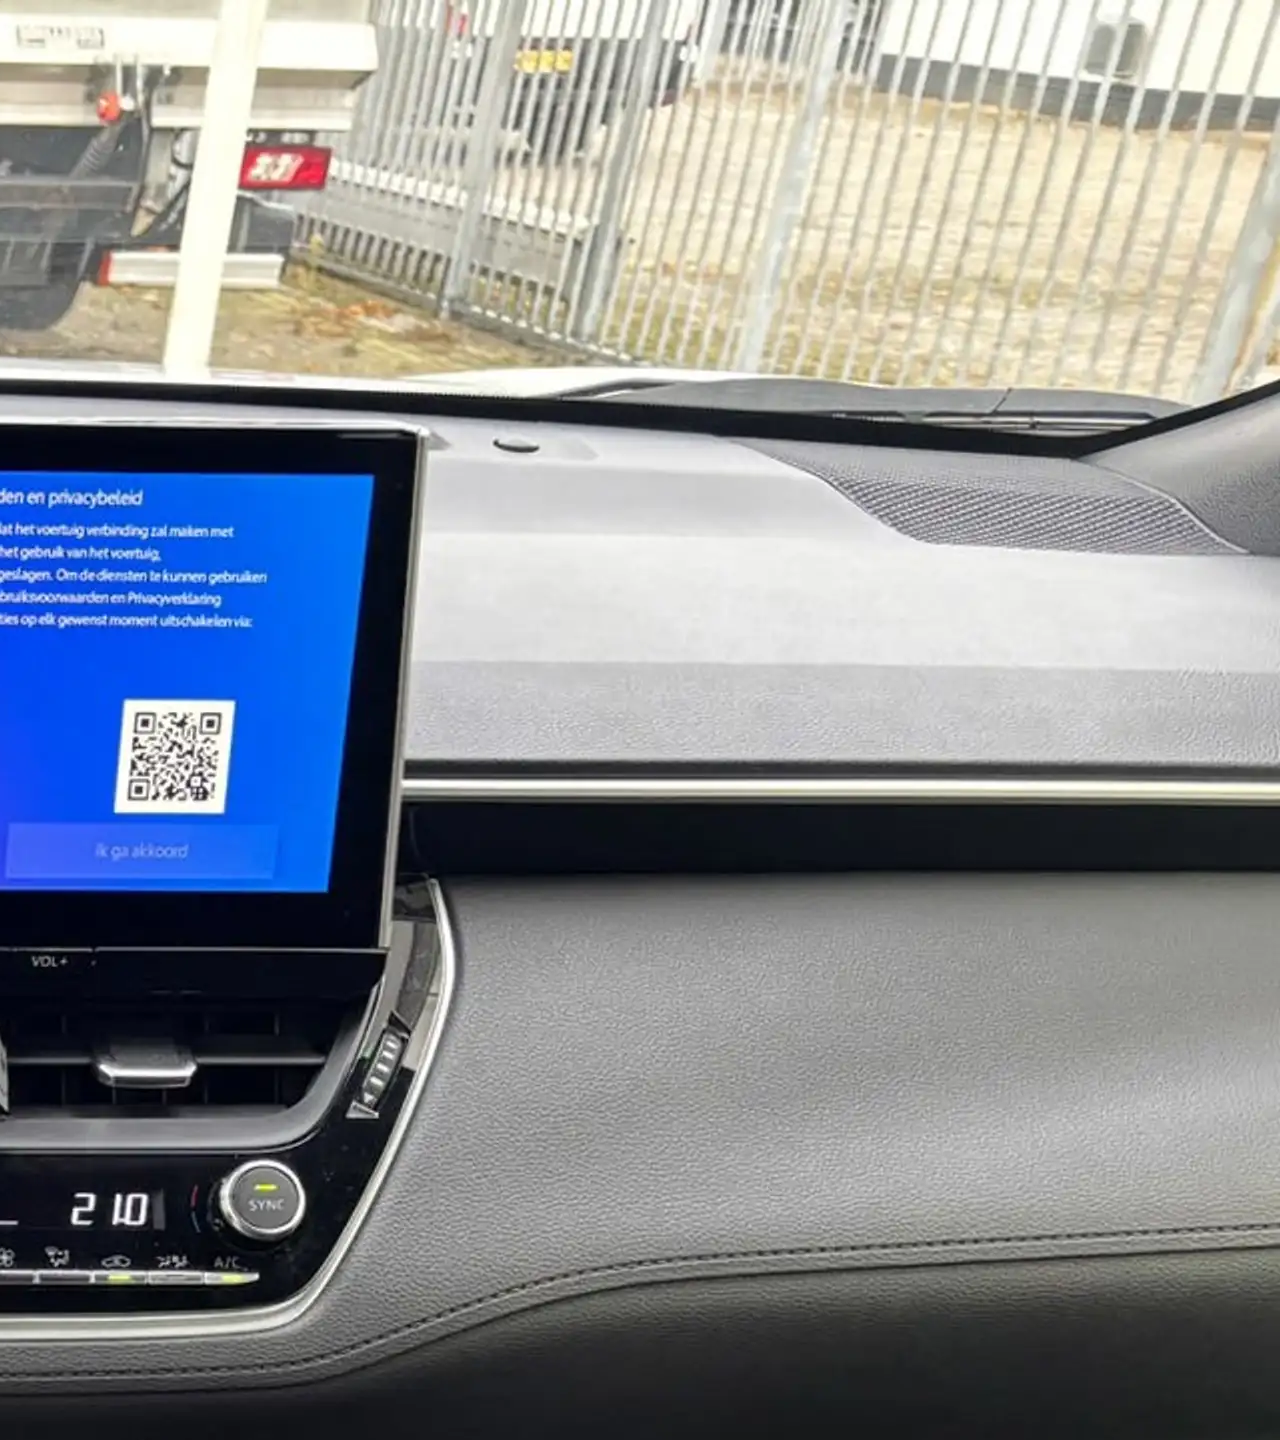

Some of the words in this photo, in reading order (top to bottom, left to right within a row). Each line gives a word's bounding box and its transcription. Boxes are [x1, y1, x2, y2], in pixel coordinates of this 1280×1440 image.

[26, 493, 46, 505] en
[48, 488, 143, 509] privacybeleid
[95, 843, 109, 857] Ik
[110, 847, 129, 861] ga
[130, 843, 190, 857] akkoord
[248, 1199, 285, 1211] SYNC
[214, 1255, 240, 1269] A/C
